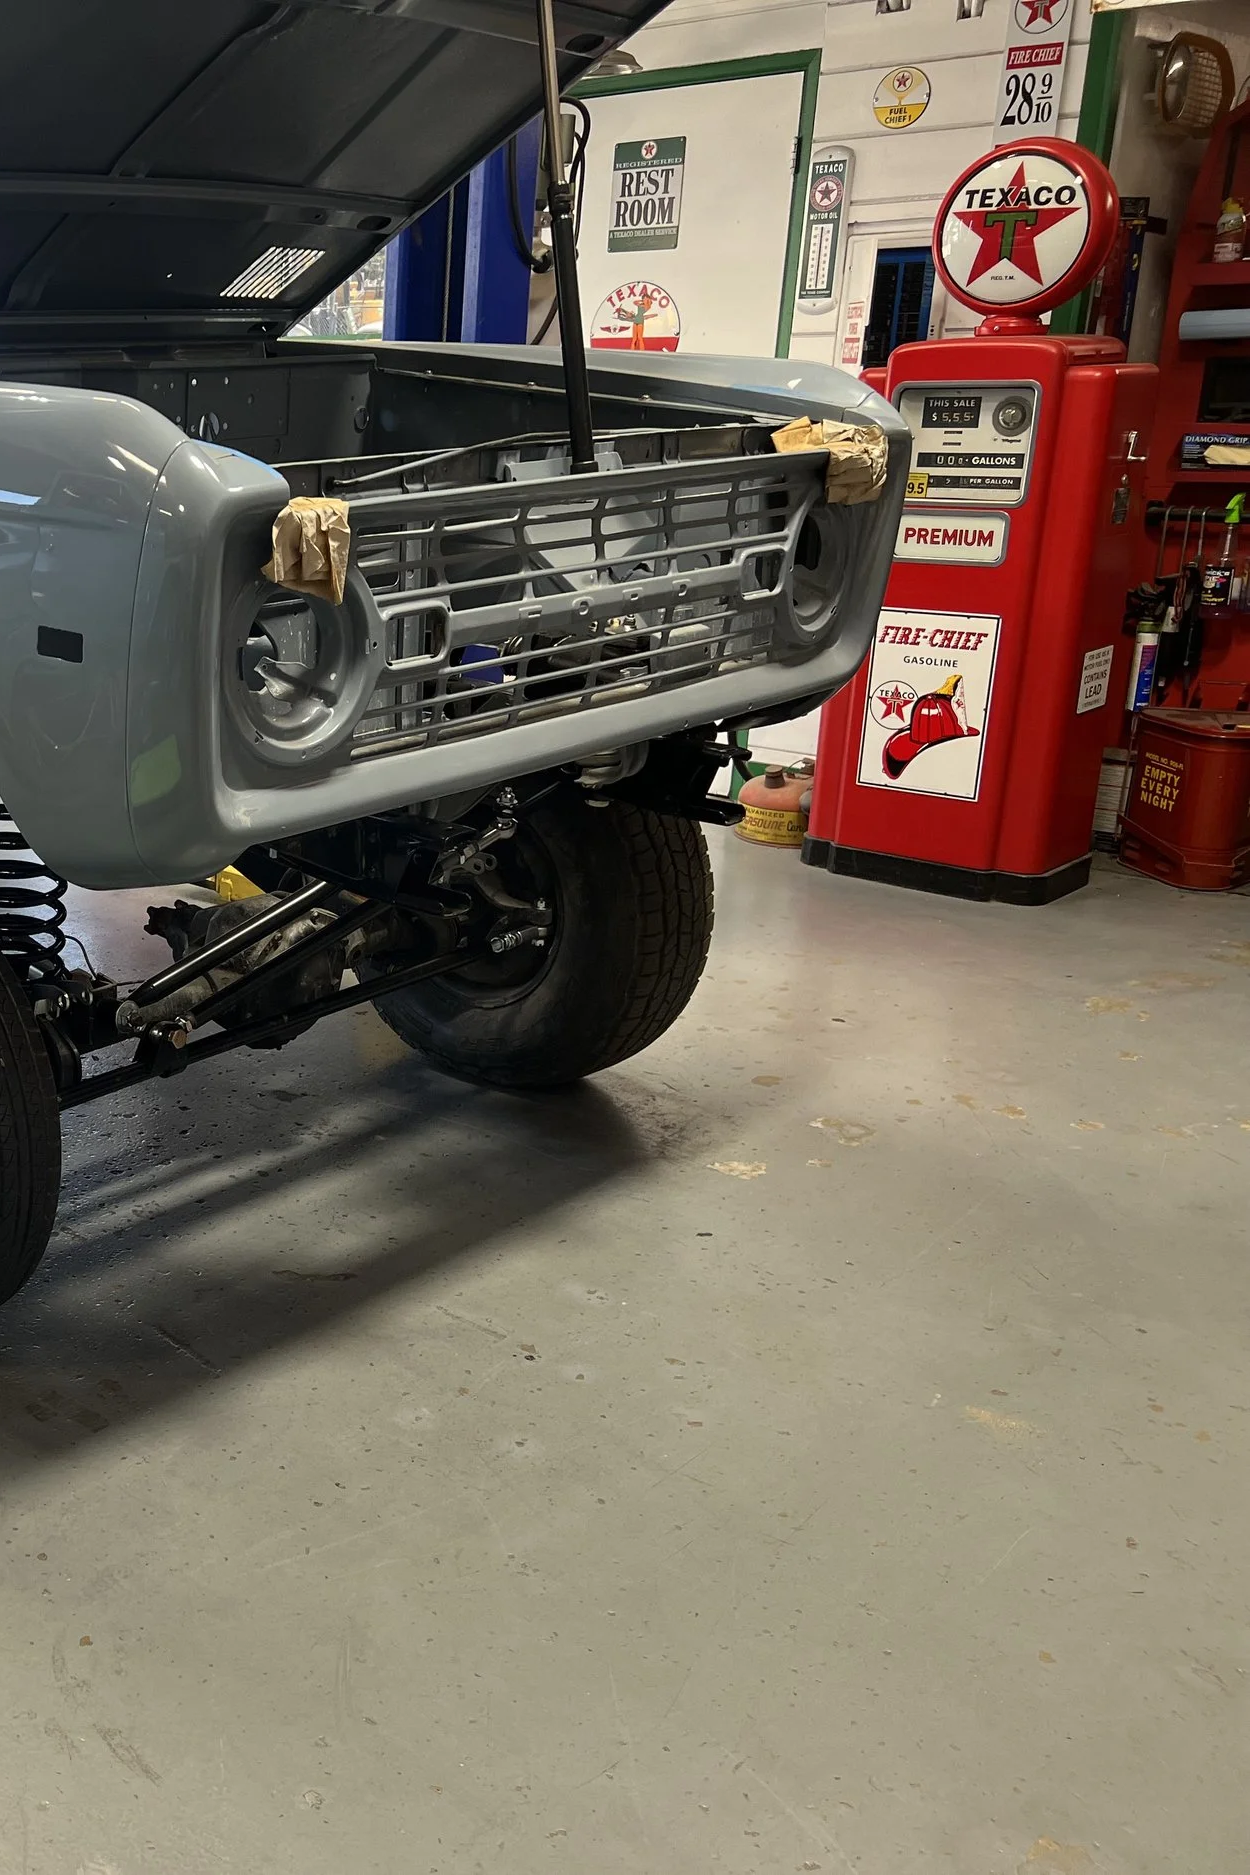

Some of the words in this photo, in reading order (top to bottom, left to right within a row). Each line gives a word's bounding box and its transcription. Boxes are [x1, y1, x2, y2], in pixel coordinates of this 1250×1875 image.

[1008, 50, 1031, 65] FIRE
[1032, 47, 1062, 63] CHIEF
[1000, 73, 1036, 126] 28
[1041, 73, 1053, 95] 9
[884, 115, 908, 124] CHIEF
[889, 107, 908, 116] FUEL
[1032, 101, 1052, 124] 10
[615, 157, 682, 169] REGISTERED
[815, 163, 844, 174] TEXACO
[619, 168, 675, 198] REST
[965, 185, 1077, 209] TEXACO
[613, 197, 676, 228] ROOM
[810, 212, 828, 220] MOTOR
[614, 230, 634, 238] TEXACO
[983, 210, 1038, 262] T
[606, 284, 670, 309] TEXACO
[929, 399, 950, 407] THIS
[953, 399, 976, 407] SALE
[1185, 435, 1227, 444] DIAMOND
[1227, 436, 1248, 444] GRIP
[971, 456, 1016, 465] GALLONS
[903, 527, 995, 547] PREMIUM
[878, 625, 989, 651] FIRE-CHIEF
[903, 655, 959, 668] GASOLINE
[1084, 669, 1108, 685] CONTAINS
[880, 689, 915, 700] TEXACO
[1085, 683, 1102, 699] LEAD
[1144, 764, 1181, 787] EMPTY
[1140, 777, 1180, 800] EVERY
[1140, 790, 1175, 812] NIGHT
